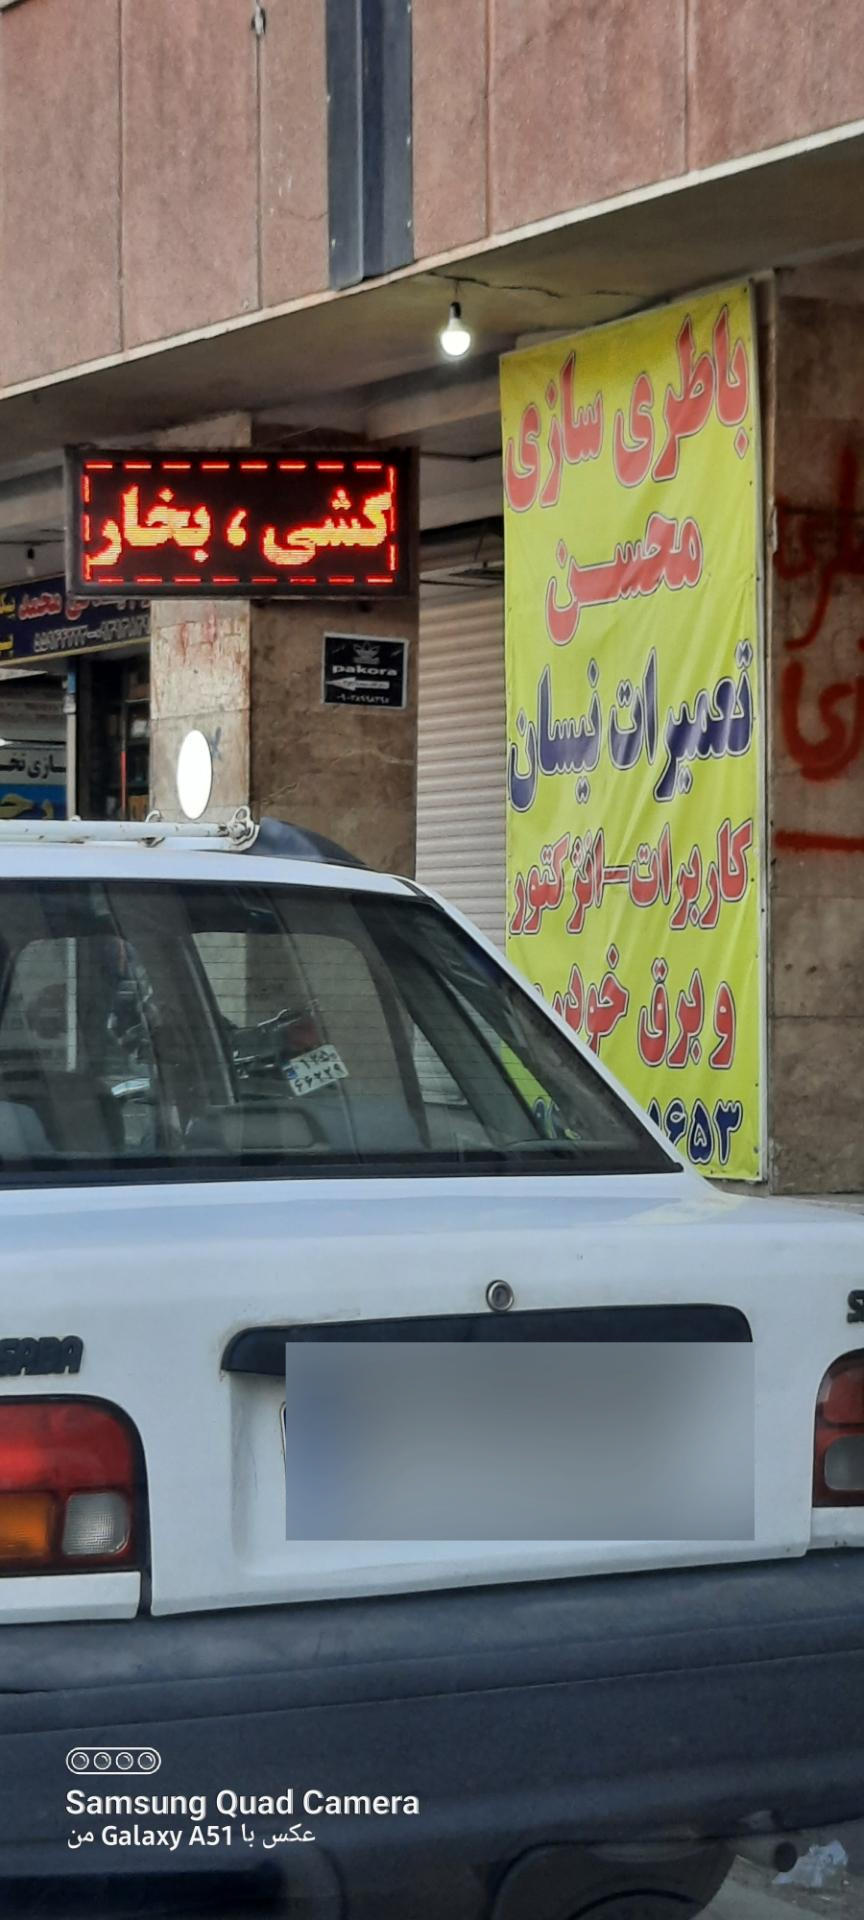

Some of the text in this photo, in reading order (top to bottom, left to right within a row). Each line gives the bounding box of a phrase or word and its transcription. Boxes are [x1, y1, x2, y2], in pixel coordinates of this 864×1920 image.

[505, 305, 750, 513] باطری سازی
[86, 485, 212, 566] بخار
[546, 511, 703, 646] محسن
[332, 664, 398, 676] pakora
[508, 638, 754, 814] تعمیرات نیسان
[638, 958, 705, 1068] برق
[709, 981, 736, 1070] و
